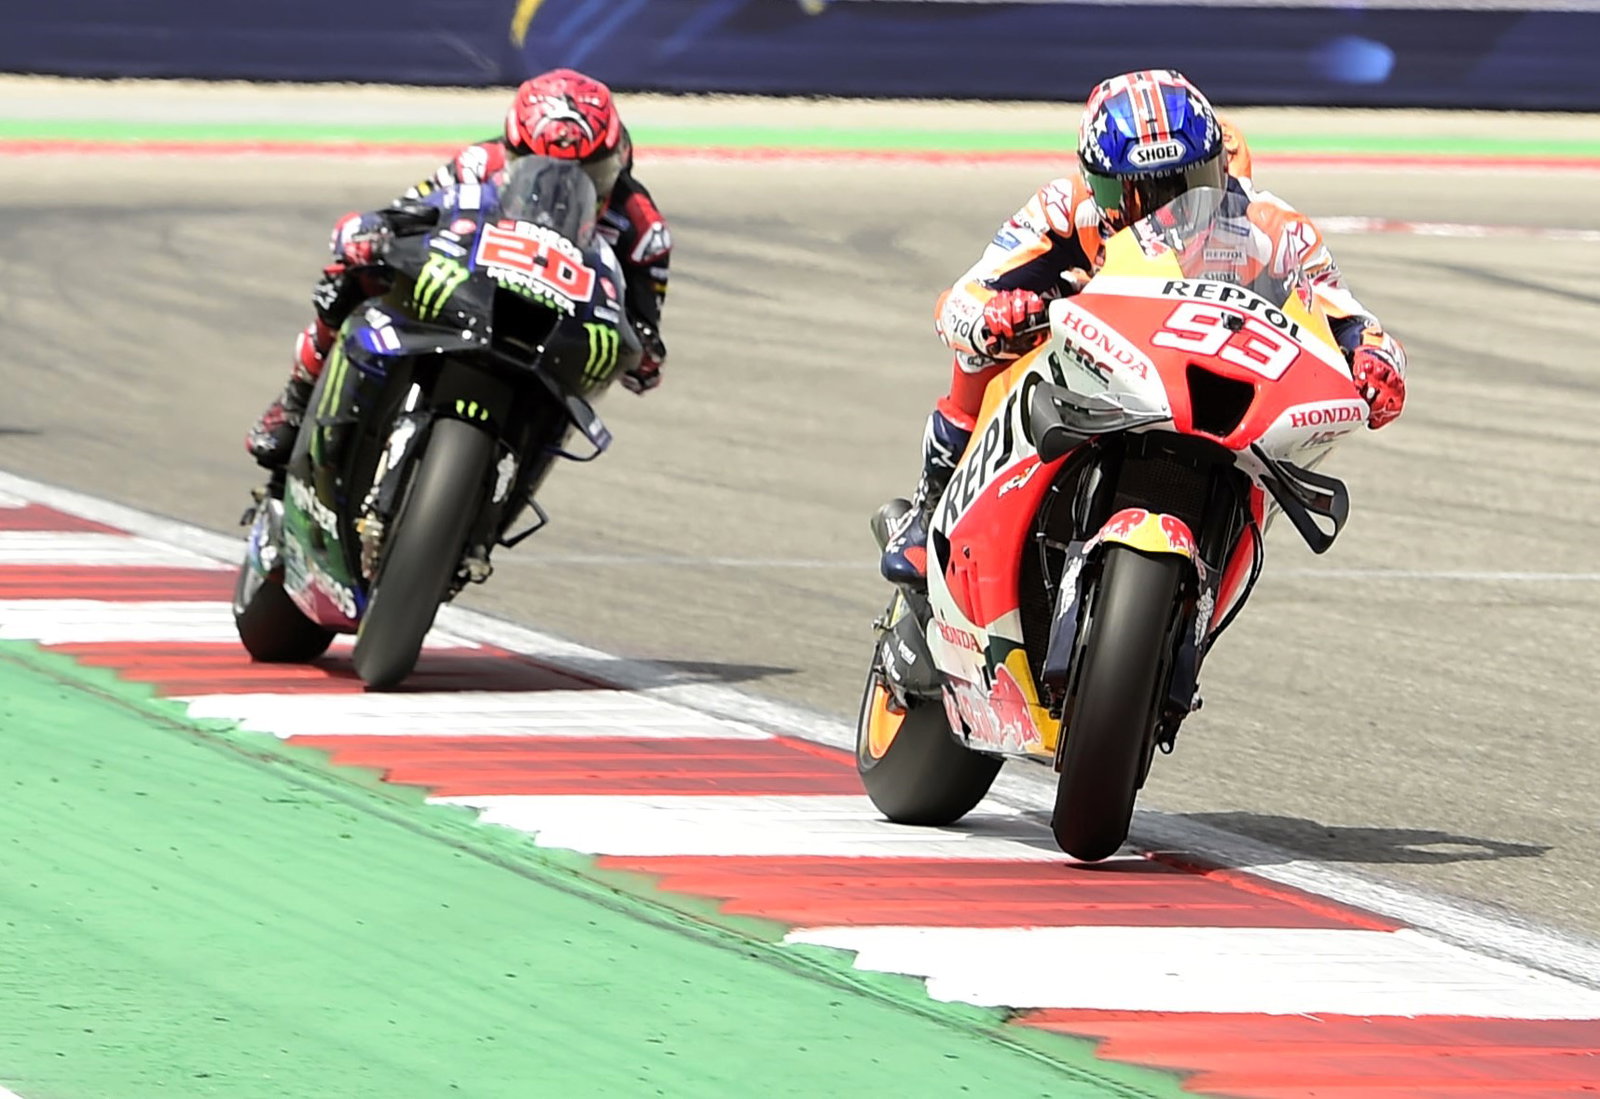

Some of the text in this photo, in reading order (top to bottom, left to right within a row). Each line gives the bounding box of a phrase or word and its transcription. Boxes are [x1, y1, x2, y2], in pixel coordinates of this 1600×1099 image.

[1137, 144, 1178, 162] SHOEI
[1149, 169, 1171, 180] YOU
[1205, 250, 1242, 259] REPSOL
[1162, 280, 1302, 344] REPSOL
[1061, 311, 1148, 381] HONDA
[1150, 300, 1301, 382] 93
[1063, 337, 1114, 384] HRC
[1289, 406, 1363, 428] HONDA
[937, 621, 983, 654] HONDA
